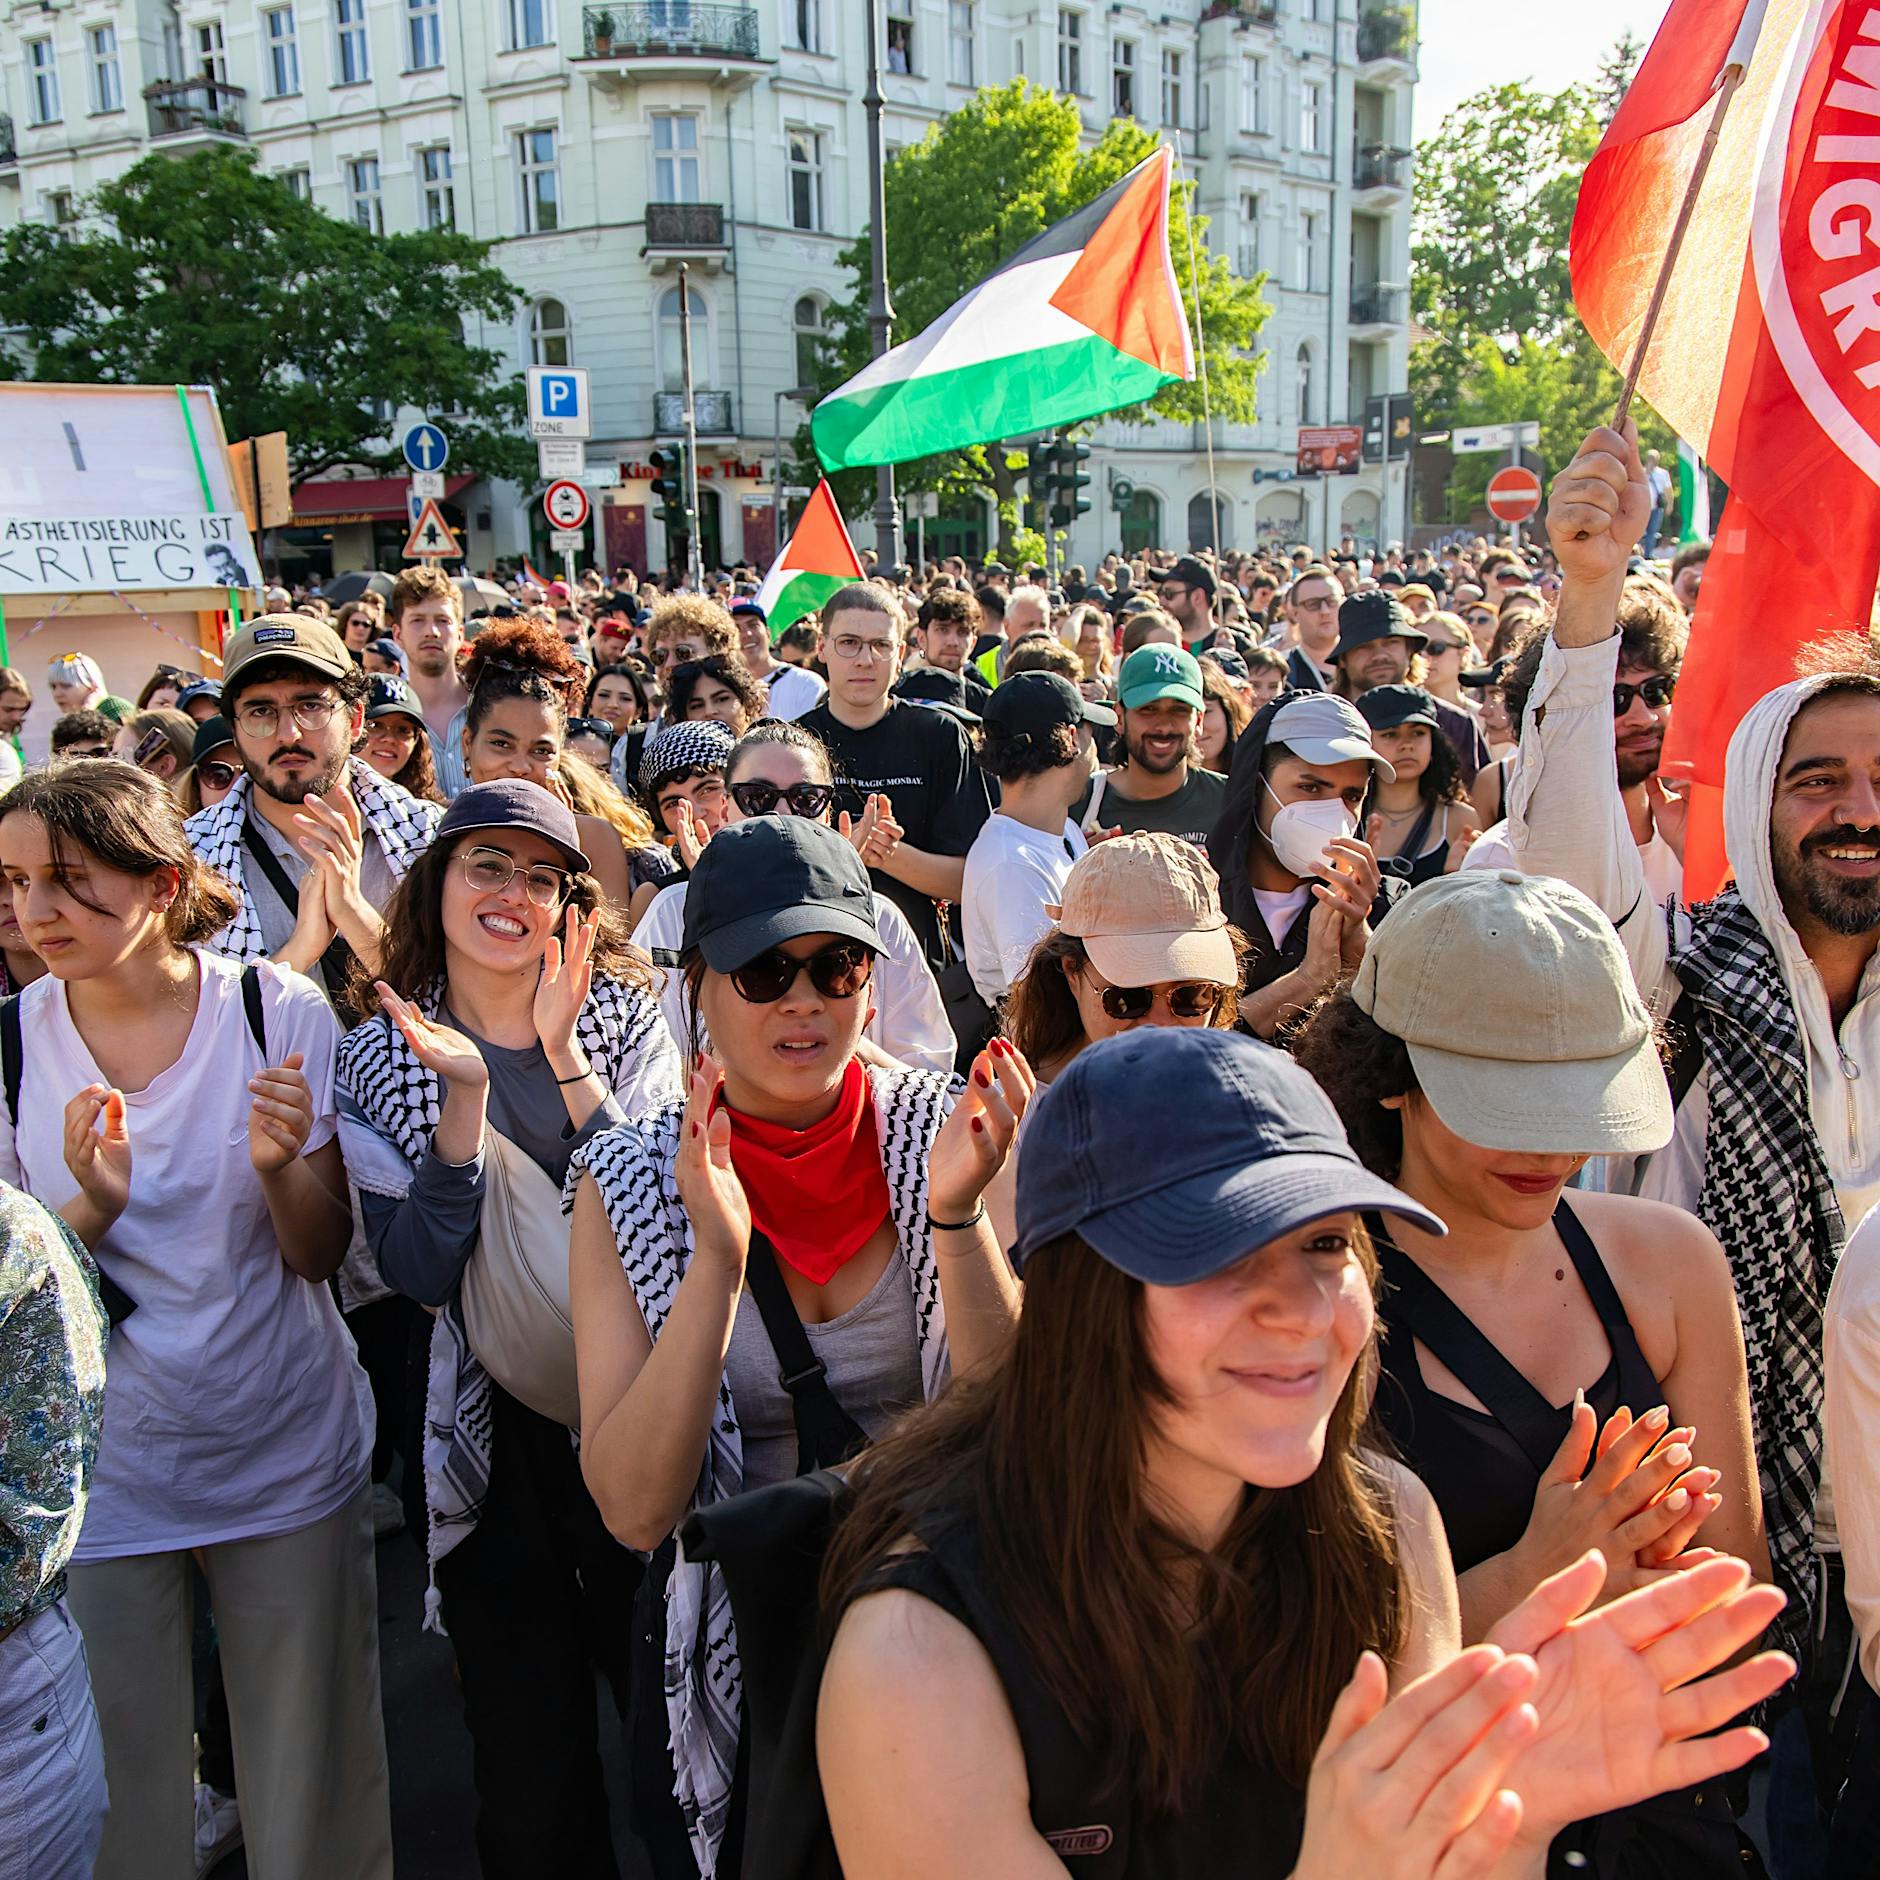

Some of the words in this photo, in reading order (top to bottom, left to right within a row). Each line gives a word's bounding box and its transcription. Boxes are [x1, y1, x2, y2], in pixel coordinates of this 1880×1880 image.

[549, 380, 569, 412] P
[533, 421, 564, 434] ZONE
[719, 458, 762, 479] Thai
[5, 517, 186, 541] ÄSTHETISIERUNG
[200, 517, 233, 542] IST
[0, 542, 195, 584] KRIEG
[886, 776, 923, 787] MONDAY.
